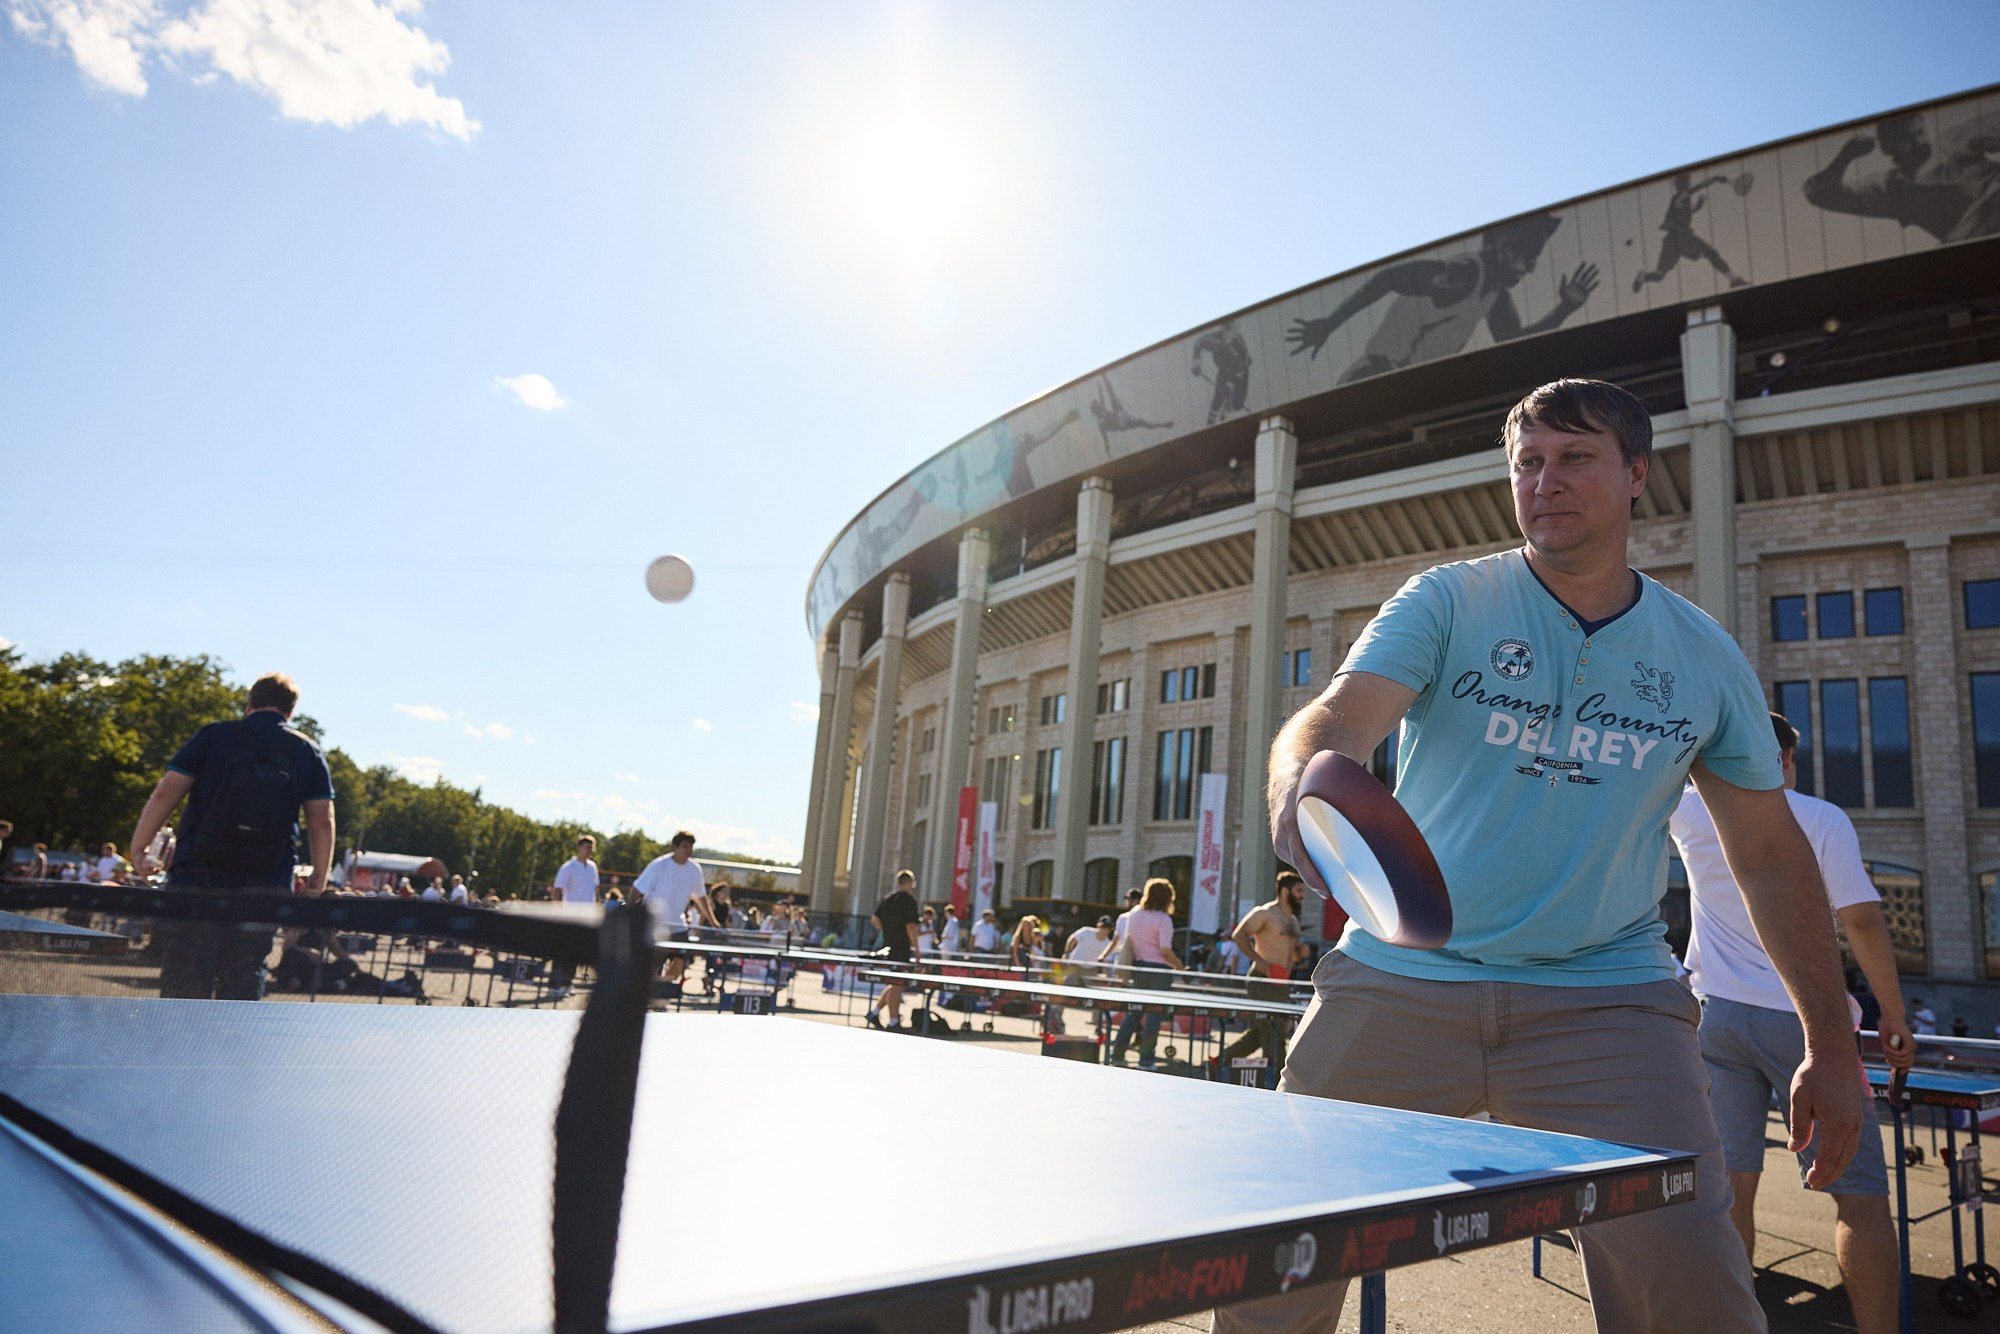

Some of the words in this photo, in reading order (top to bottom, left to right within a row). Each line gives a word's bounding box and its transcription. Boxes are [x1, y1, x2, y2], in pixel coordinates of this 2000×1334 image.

[1452, 670, 1562, 729] Orange
[1576, 693, 1698, 764] County
[1484, 711, 1555, 755] DEL
[1568, 725, 1659, 770] REY
[1538, 758, 1578, 769] CALIFORNIA
[1571, 775, 1587, 784] 1956
[743, 996, 761, 1014] 113
[1240, 1069, 1257, 1088] 114
[1670, 1174, 1682, 1196] LIGA
[1682, 1171, 1694, 1193] PRO
[1447, 1213, 1469, 1245] LIGA
[1470, 1211, 1490, 1240] PRO
[1001, 1283, 1049, 1334] LIGA
[1052, 1276, 1095, 1326] PRO
